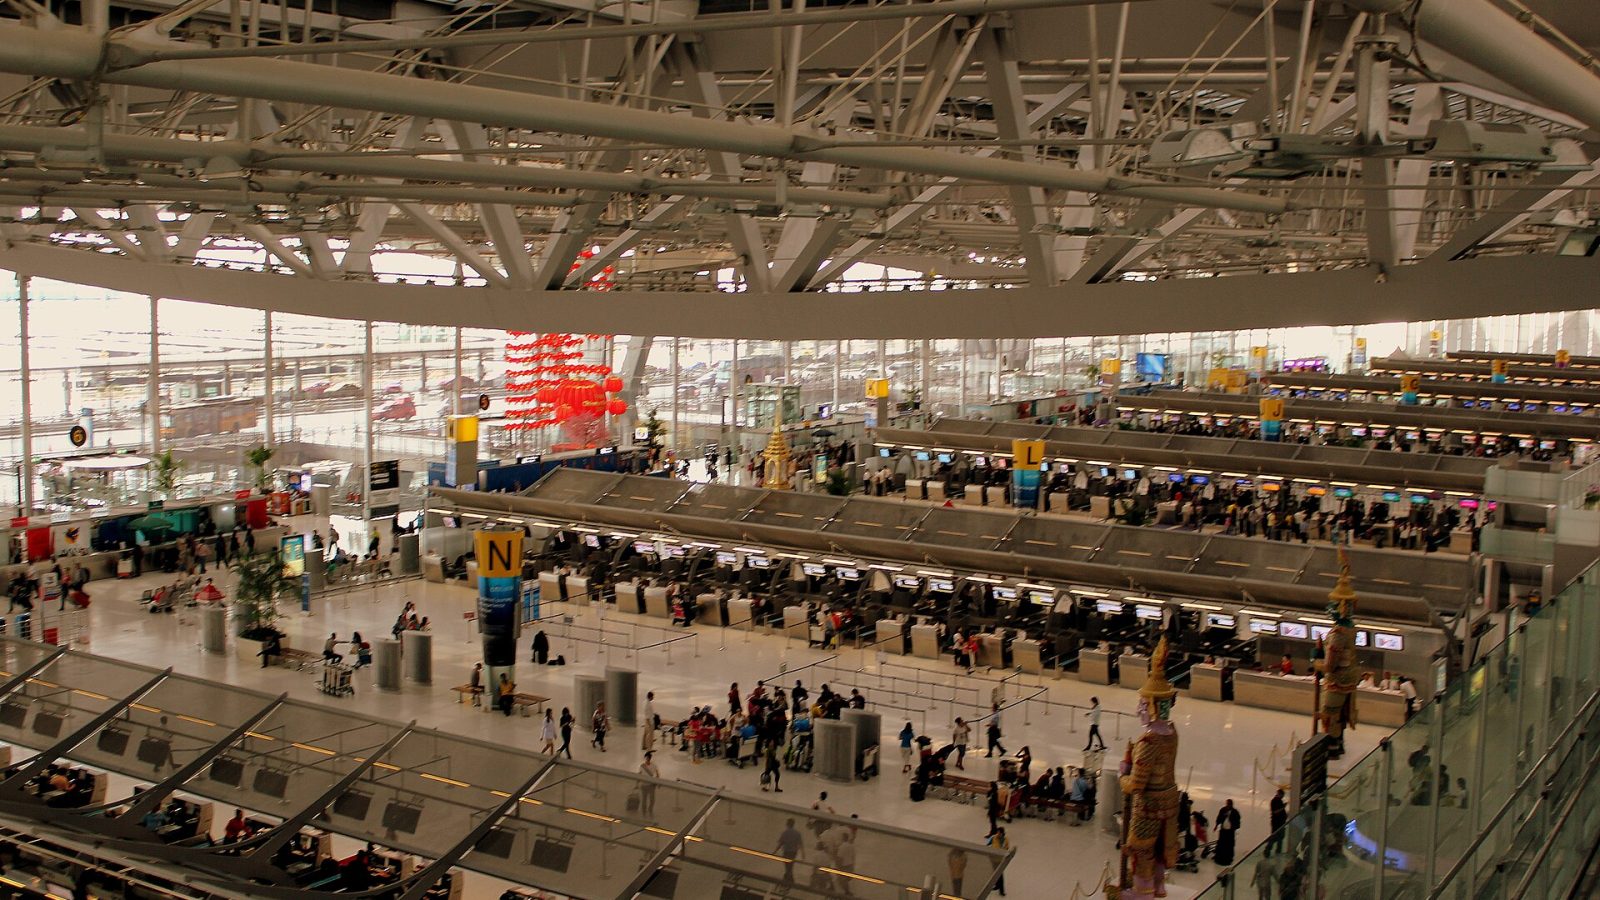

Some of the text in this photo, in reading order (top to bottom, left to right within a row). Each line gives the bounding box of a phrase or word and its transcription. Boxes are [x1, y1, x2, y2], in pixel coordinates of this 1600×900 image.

[1273, 402, 1282, 417] J
[73, 429, 83, 443] 6
[1027, 446, 1038, 465] L
[488, 540, 512, 571] N
